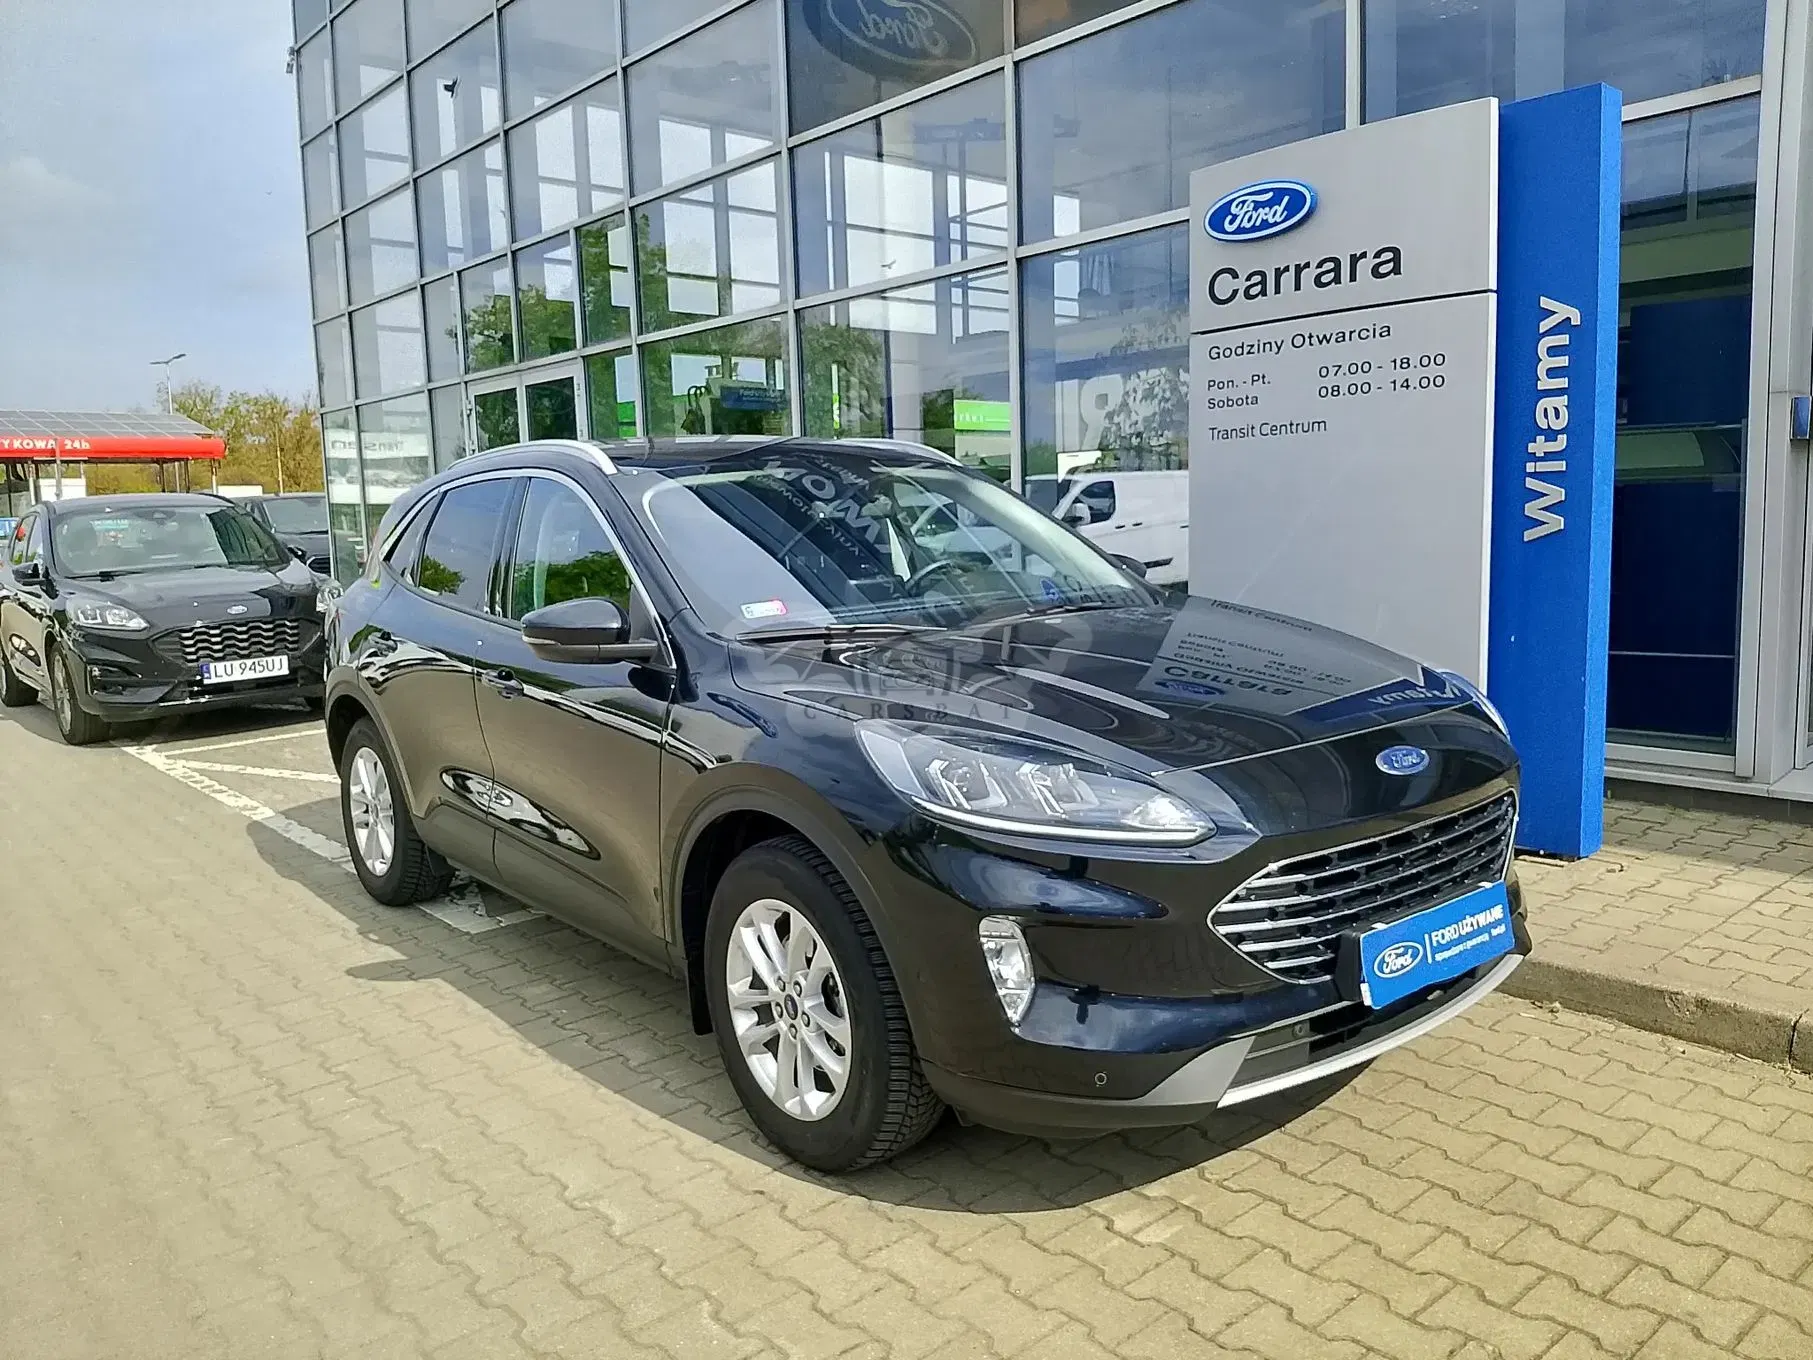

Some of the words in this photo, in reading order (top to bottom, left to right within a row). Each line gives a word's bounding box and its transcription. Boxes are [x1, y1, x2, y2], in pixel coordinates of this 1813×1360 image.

[1224, 191, 1290, 233] Ford
[1208, 246, 1403, 306] Carrara
[1208, 339, 1285, 361] Godziny
[1291, 323, 1392, 349] Otwarcia
[1318, 361, 1372, 378] 07.00
[1390, 353, 1446, 371] 18.00
[1207, 379, 1239, 391] Pon.
[1251, 374, 1271, 386] Pt.
[1318, 381, 1372, 398] 08.00
[1390, 375, 1446, 392] 14.00
[1207, 394, 1259, 410] Sobota
[1208, 424, 1255, 441] Transit
[1259, 419, 1327, 437] Centrum
[1523, 296, 1582, 542] Witamy
[214, 663, 234, 678] LU
[239, 658, 283, 676] 945UJ
[1431, 923, 1459, 947] FORD
[1458, 904, 1504, 936] UŻYWANE
[1382, 946, 1413, 974] Ford
